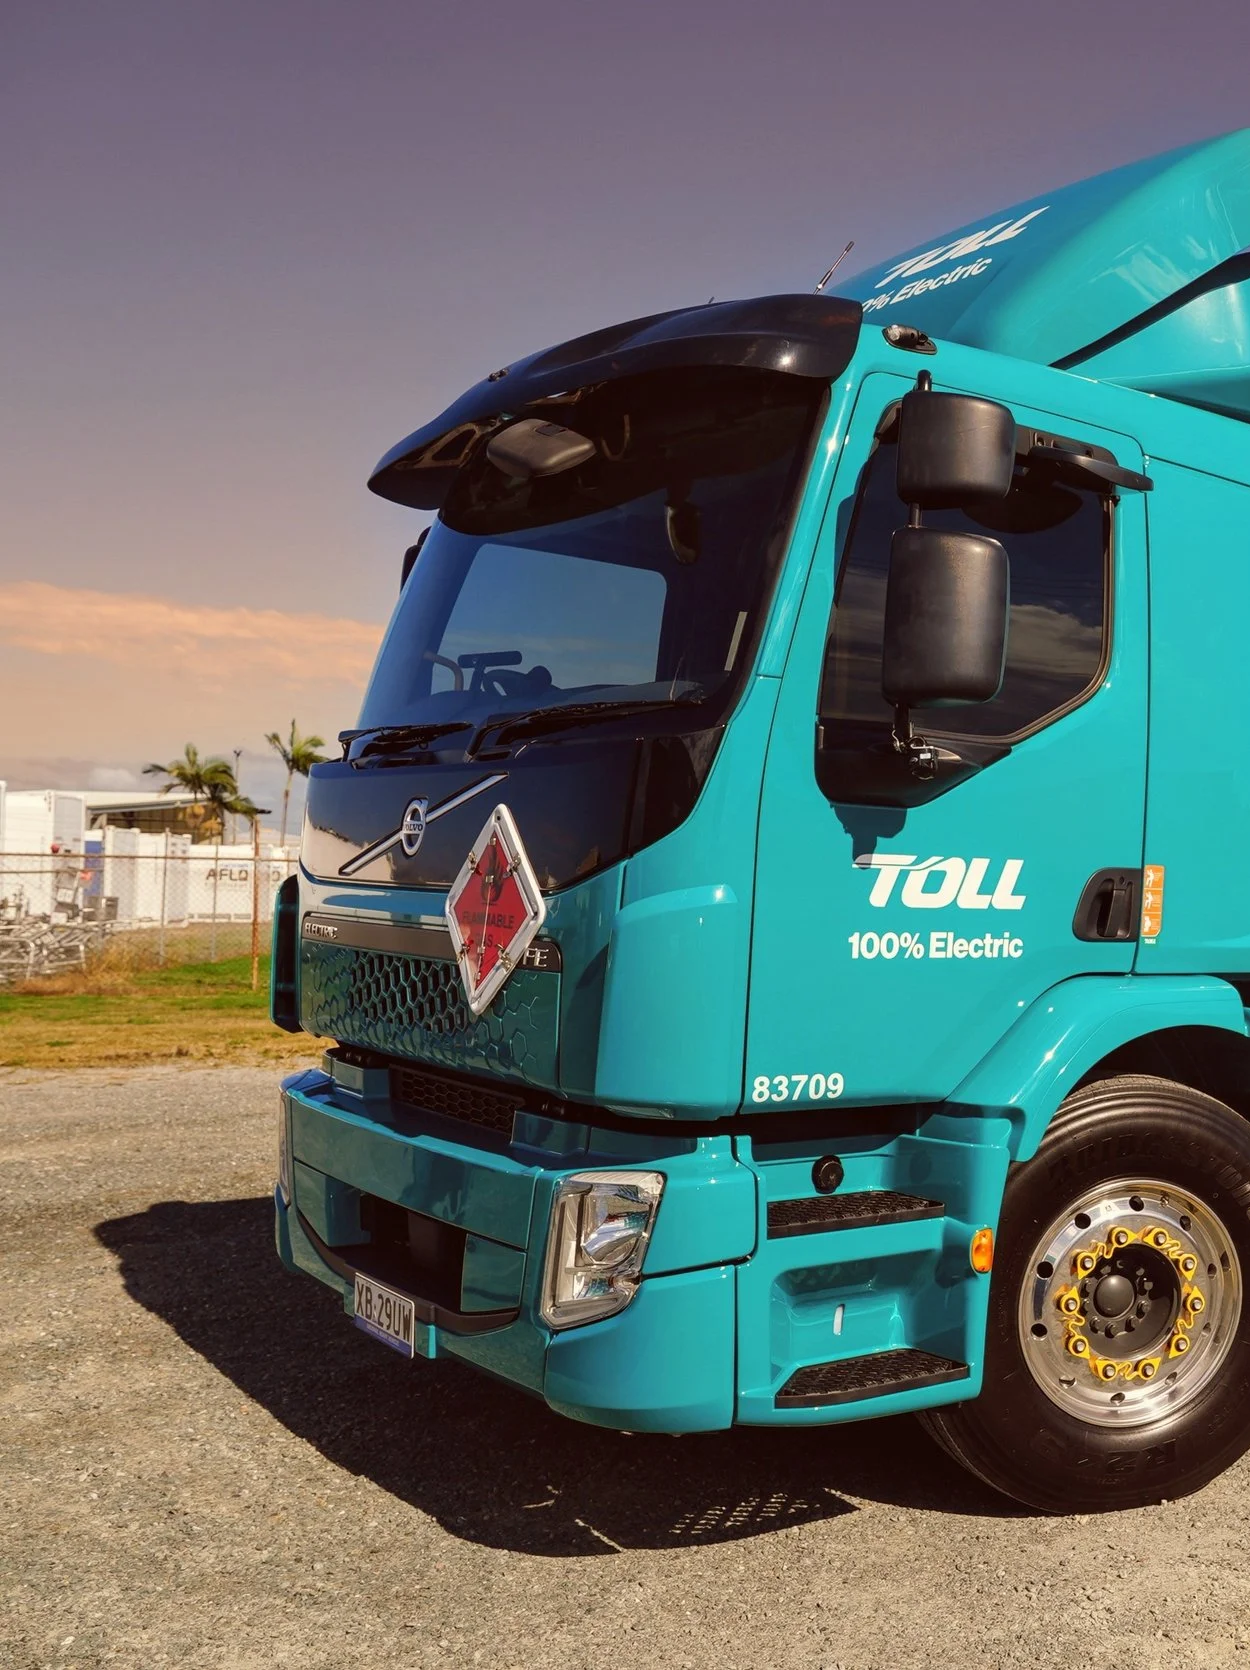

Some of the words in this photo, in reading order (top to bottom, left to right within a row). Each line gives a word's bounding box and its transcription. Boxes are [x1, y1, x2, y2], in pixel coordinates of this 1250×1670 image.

[889, 258, 993, 305] Electric
[851, 853, 1027, 910] TOLL
[463, 911, 515, 929] FLAMMABLE
[522, 946, 549, 967] FE
[848, 931, 925, 960] 100%
[929, 931, 1024, 959] Electric
[751, 1072, 844, 1103] 83709
